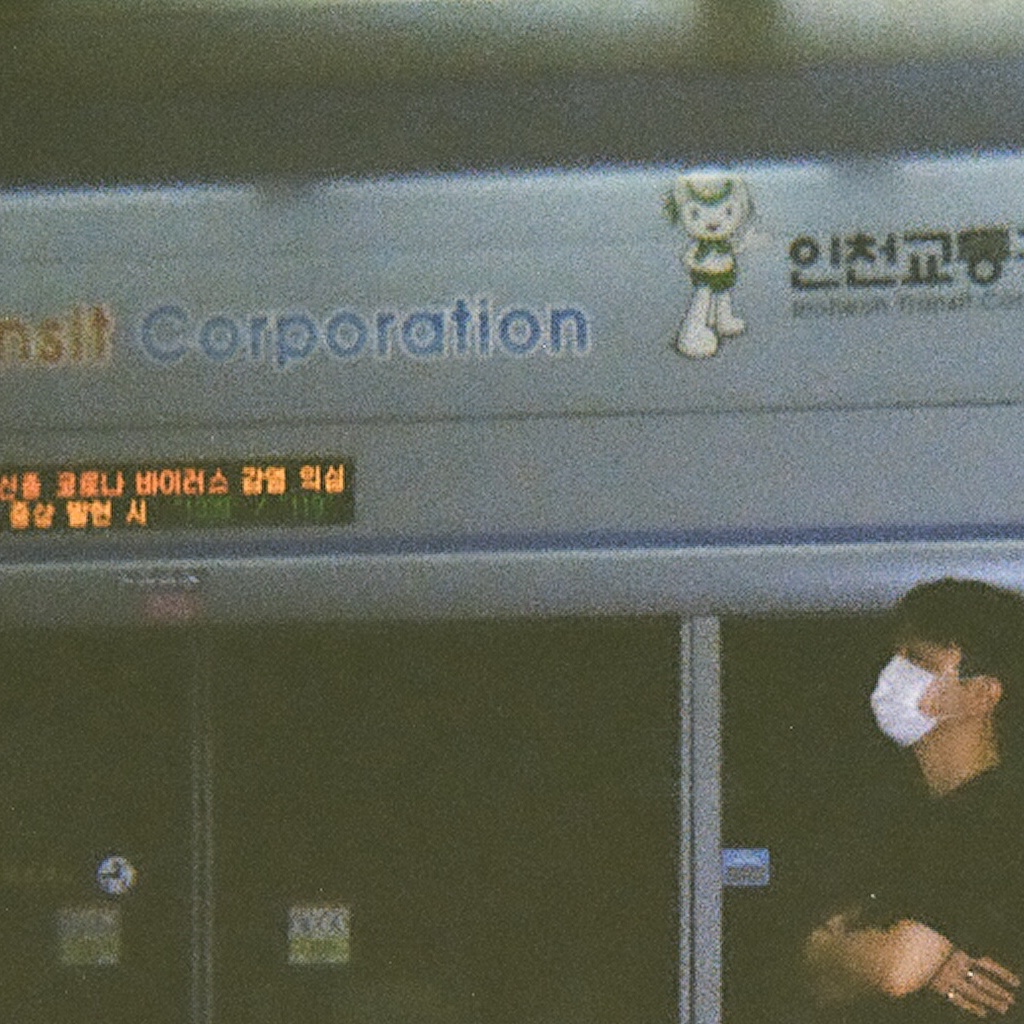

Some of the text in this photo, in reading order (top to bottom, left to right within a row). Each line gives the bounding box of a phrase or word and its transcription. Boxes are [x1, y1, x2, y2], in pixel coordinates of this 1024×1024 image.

[141, 299, 589, 368] Corporation
[57, 470, 125, 498] 코로나
[135, 468, 228, 496] 바이러스
[300, 464, 345, 494] 의심
[126, 499, 147, 526] 시
